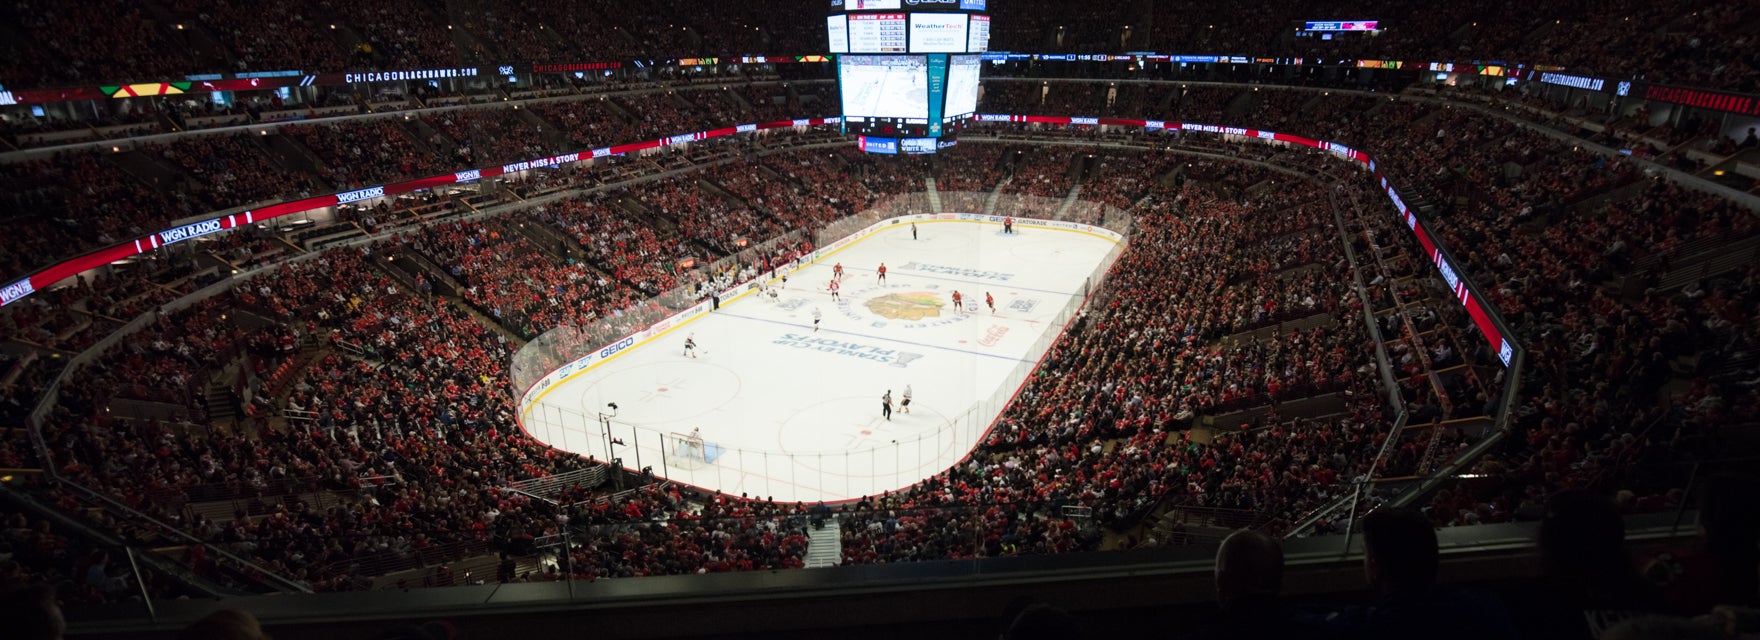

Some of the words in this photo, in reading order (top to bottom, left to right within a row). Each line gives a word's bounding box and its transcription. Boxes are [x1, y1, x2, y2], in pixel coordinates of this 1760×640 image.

[345, 68, 477, 83] CHICAGOBLACKHAWKS.COM
[1182, 123, 1201, 131] NEVER
[1202, 125, 1218, 133] MISS
[1225, 127, 1247, 135] STORY
[503, 161, 529, 173] NEVER
[531, 158, 548, 168] MISS
[549, 157, 556, 165] A
[556, 153, 579, 164] STORY
[338, 191, 359, 202] WGN
[360, 187, 384, 198] RADIO
[161, 227, 187, 242] WGN
[187, 220, 220, 236] RADIO
[0, 283, 24, 302] WGN
[600, 337, 634, 359] GEICO
